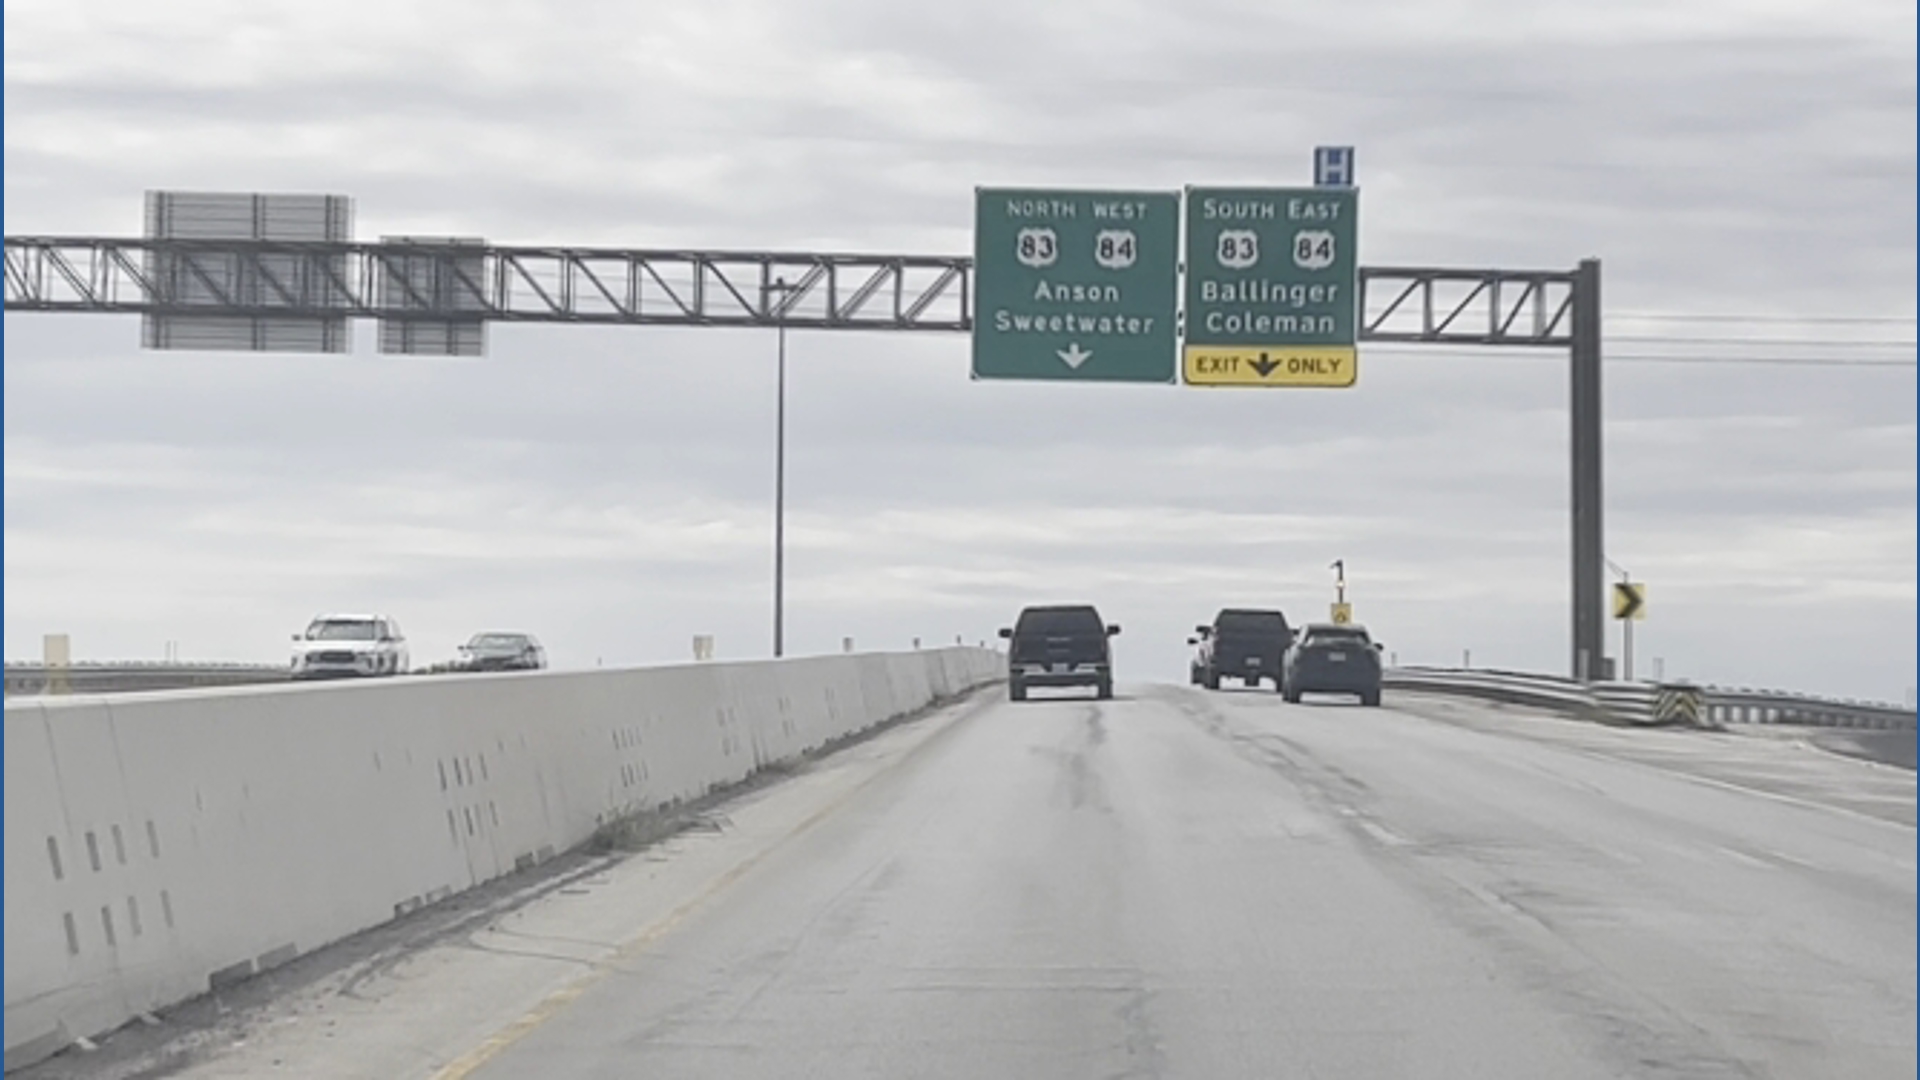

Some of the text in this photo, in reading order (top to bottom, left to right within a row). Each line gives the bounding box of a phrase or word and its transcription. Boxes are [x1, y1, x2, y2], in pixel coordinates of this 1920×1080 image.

[1319, 148, 1348, 184] H
[1007, 201, 1146, 218] NORTH WEST
[1204, 200, 1340, 219] SOUTH EAST
[1021, 236, 1054, 257] 83
[1100, 237, 1132, 258] 84
[1222, 238, 1254, 259] 83
[1298, 238, 1330, 259] 84
[1034, 282, 1119, 301] Anson
[1202, 282, 1337, 307] Ballinger
[995, 311, 1154, 334] Sweetwater
[1206, 312, 1335, 334] Coleman
[1196, 357, 1341, 373] EXIT ONLY
